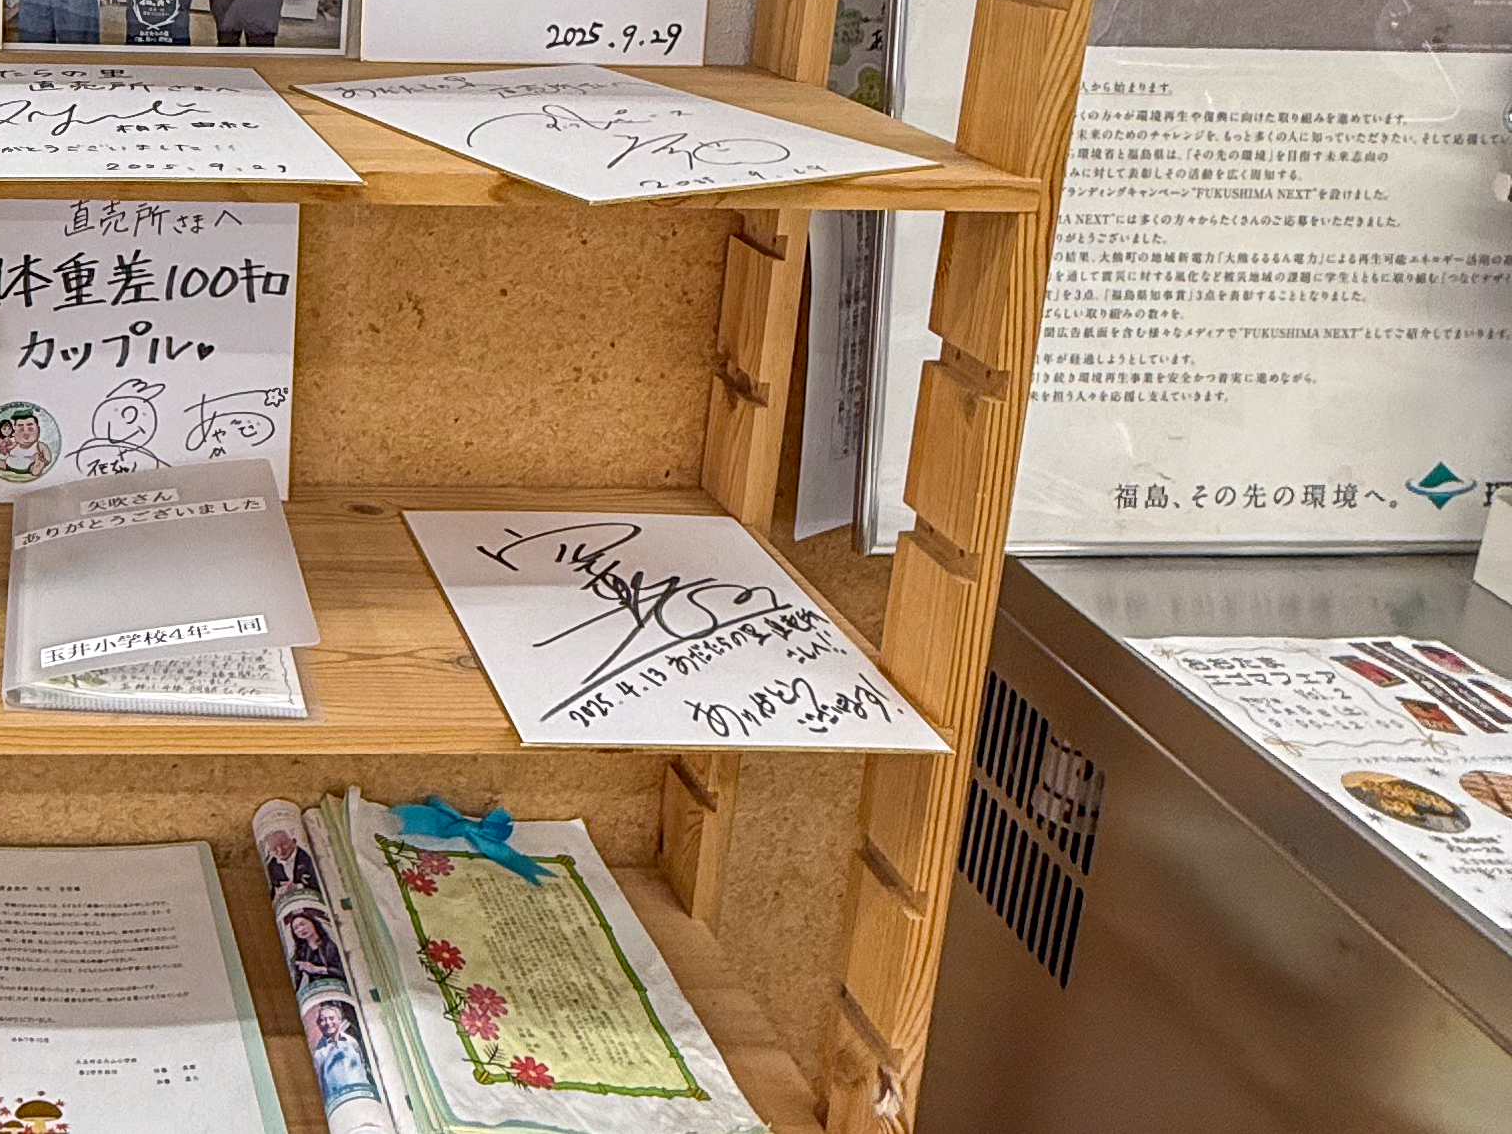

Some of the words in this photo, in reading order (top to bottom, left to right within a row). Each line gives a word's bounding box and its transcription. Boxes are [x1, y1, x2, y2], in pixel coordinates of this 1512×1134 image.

[545, 22, 683, 56] 2025.9.29
[1075, 109, 1407, 126] くの方々が環境再生や復興に向けた取り組みを進めています。
[17, 320, 194, 371] カップル
[88, 490, 173, 512] 矢吹さん
[1114, 482, 1398, 511] 福島、その先の環境へ。
[21, 498, 262, 546] ありがとうございました
